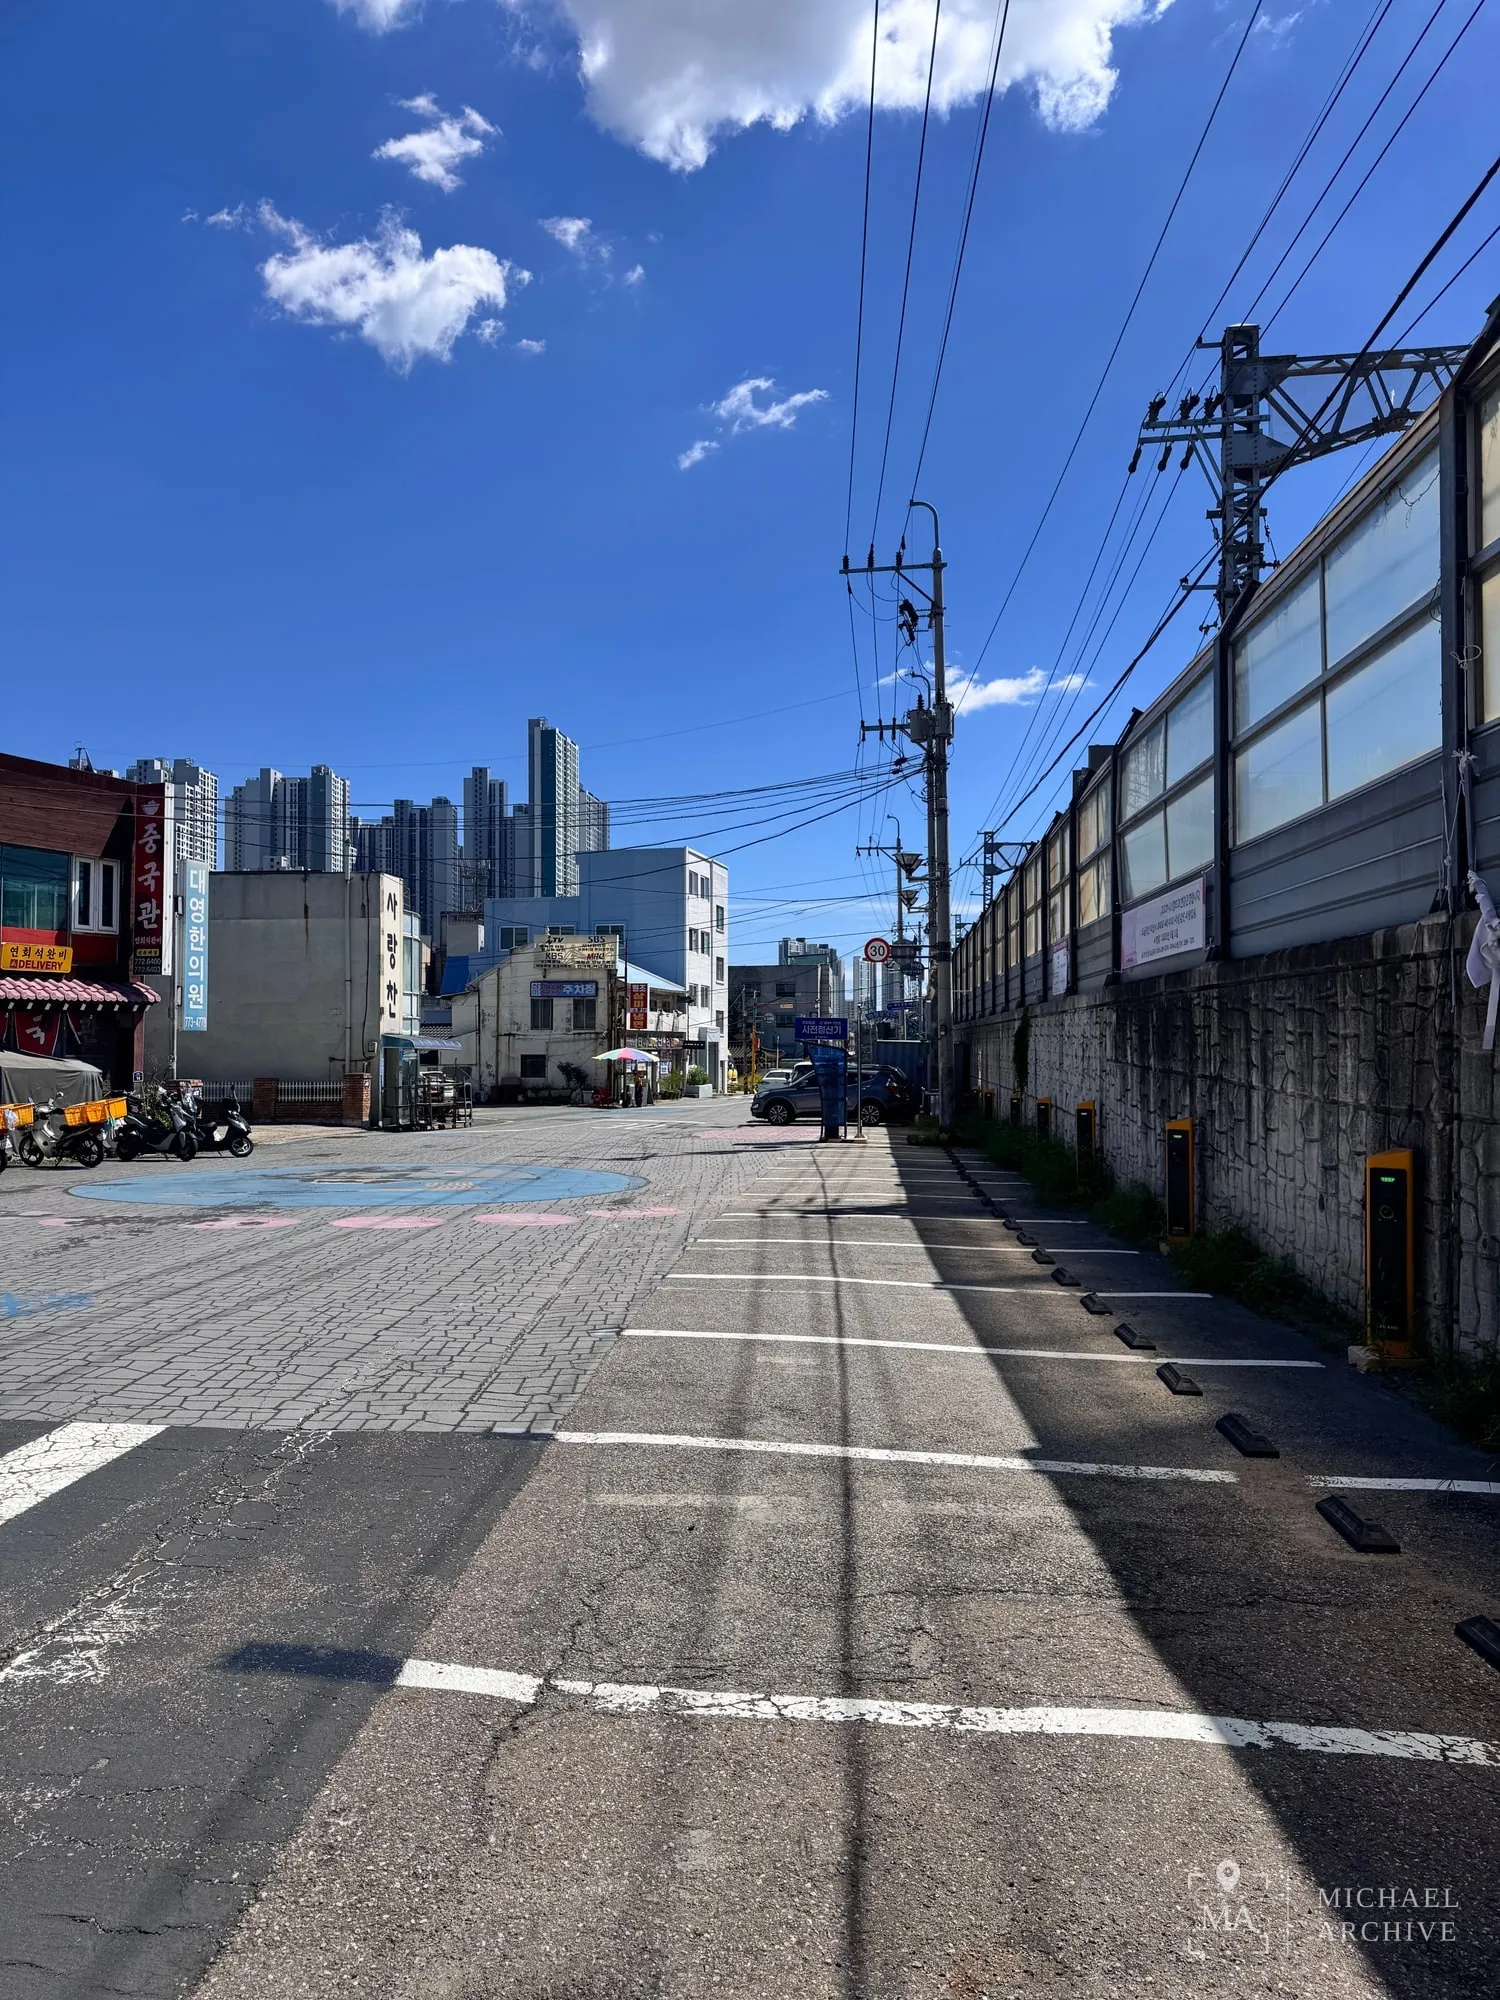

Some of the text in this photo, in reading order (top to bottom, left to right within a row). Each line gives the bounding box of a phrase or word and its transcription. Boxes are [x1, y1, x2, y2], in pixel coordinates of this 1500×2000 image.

[137, 822, 161, 930] 중국관
[188, 869, 206, 1010] 대영한의원
[10, 946, 67, 960] 연회석완비
[386, 892, 398, 1018] 사랑찬
[870, 945, 885, 956] 30
[19, 959, 63, 970] DELIVERY
[562, 984, 596, 994] 주차장
[801, 1025, 842, 1035] 사전정산기
